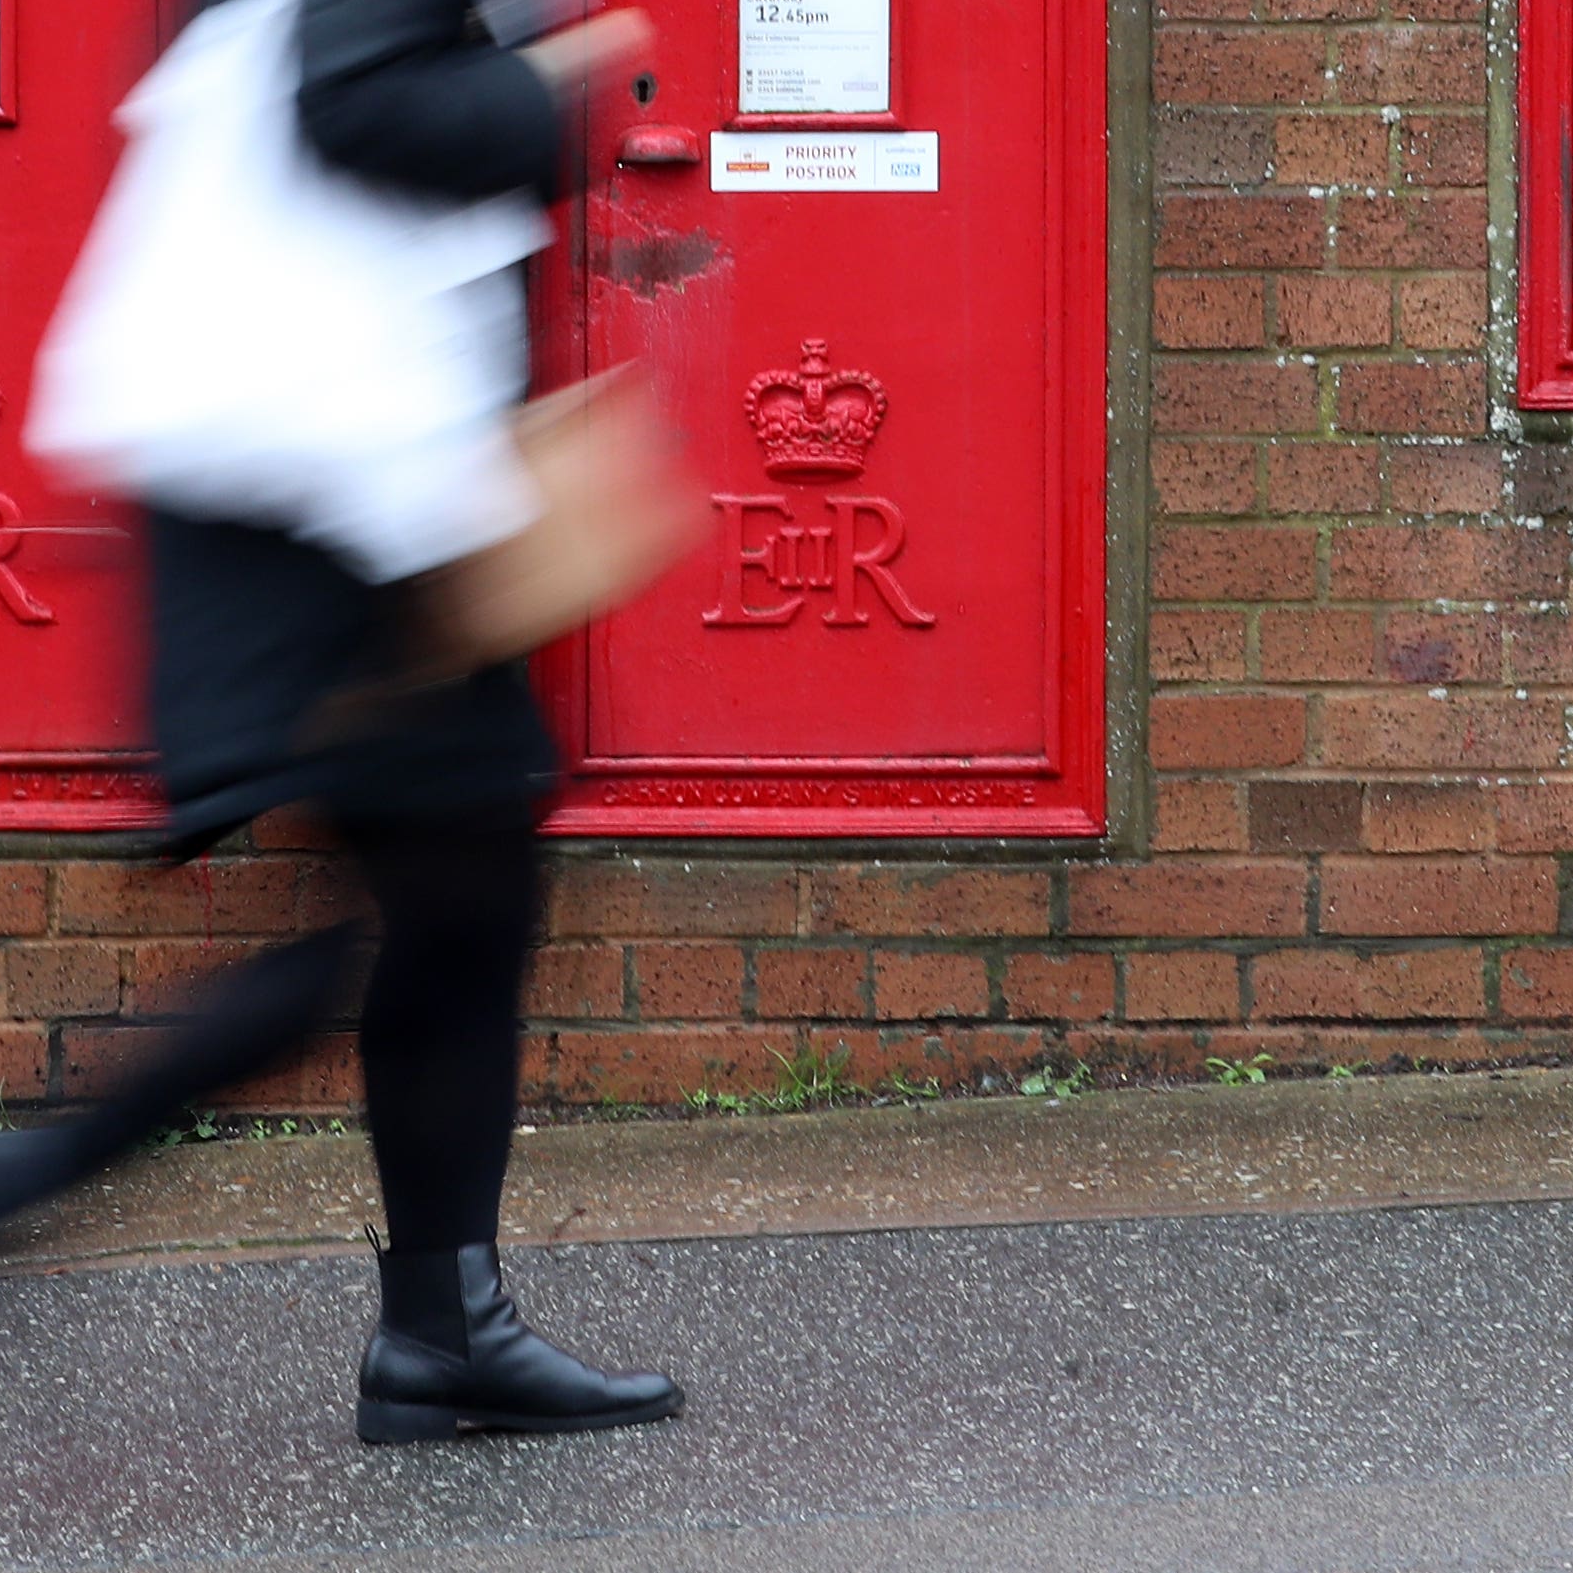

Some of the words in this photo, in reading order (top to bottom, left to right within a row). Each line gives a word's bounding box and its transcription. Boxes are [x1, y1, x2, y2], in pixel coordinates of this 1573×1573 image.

[755, 5, 830, 27] 12.45pm
[786, 145, 857, 159] PRIORITY
[786, 165, 857, 179] POSTBOX
[603, 781, 702, 804] CARRON
[714, 781, 831, 804] COMPANY
